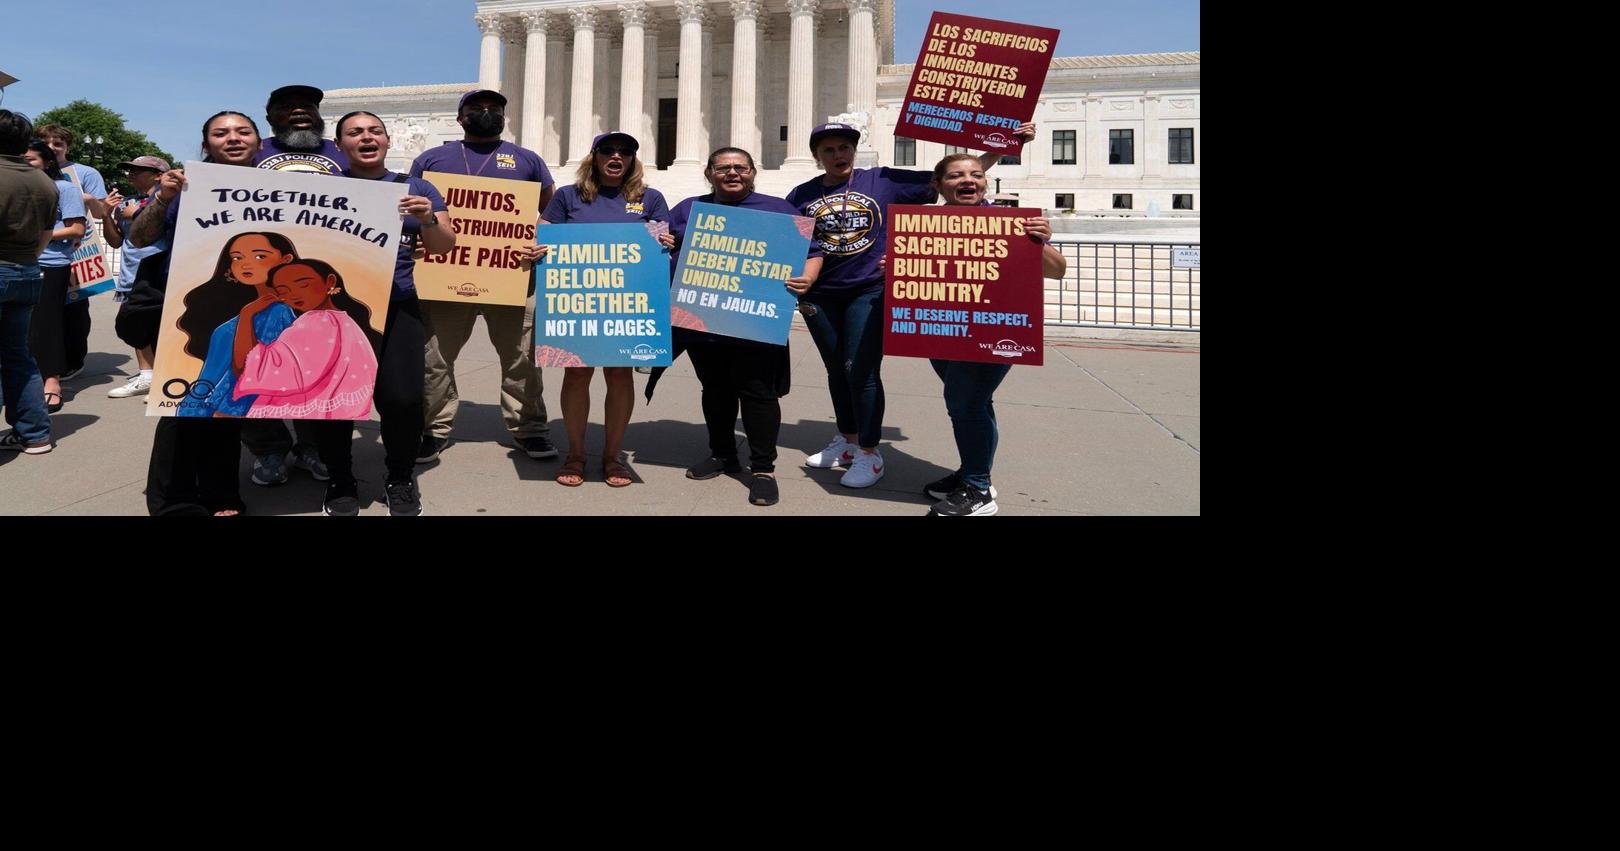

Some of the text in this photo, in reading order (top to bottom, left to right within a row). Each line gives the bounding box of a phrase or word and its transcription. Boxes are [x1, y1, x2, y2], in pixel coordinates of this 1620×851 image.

[928, 38, 977, 58] DE LOS
[932, 23, 1050, 53] LOS SACRIFICIOS
[922, 53, 1019, 81] INMIGRANTES
[918, 69, 1027, 98] CONSTRUYERON
[913, 84, 984, 108] ESTE PAÍS.
[905, 113, 964, 132] Y DIGNIDAD.
[908, 102, 1021, 130] MERECEMOS RESPETO
[1001, 137, 1019, 146] CASA
[285, 154, 334, 169] POLITICAL
[211, 188, 357, 212] TOGETHER,
[443, 188, 520, 215] JUNTOS,
[825, 195, 871, 207] POLTICAL
[195, 210, 234, 229] WE
[243, 207, 286, 222] ARE
[295, 210, 389, 248] AMERICA
[695, 213, 726, 232] LAS
[545, 243, 641, 265] FAMILIES
[691, 232, 767, 258] FAMILIAS
[817, 237, 869, 251] ORGANIZERS
[894, 236, 1008, 258] SACRIFICES
[686, 250, 793, 281] DEBEN ESTAR
[893, 258, 1000, 281] BUILT THIS
[545, 268, 624, 289] BELONG
[681, 268, 743, 293] UNIDAS.
[893, 280, 990, 303] COUNTRY.
[545, 293, 655, 314] TOGETHER.
[677, 288, 779, 318] NO EN JAULAS.
[545, 319, 661, 337] NOT IN CAGES.
[892, 307, 1032, 328] WE DESERVE RESPECT,
[891, 322, 973, 338] AND DIGNITY.
